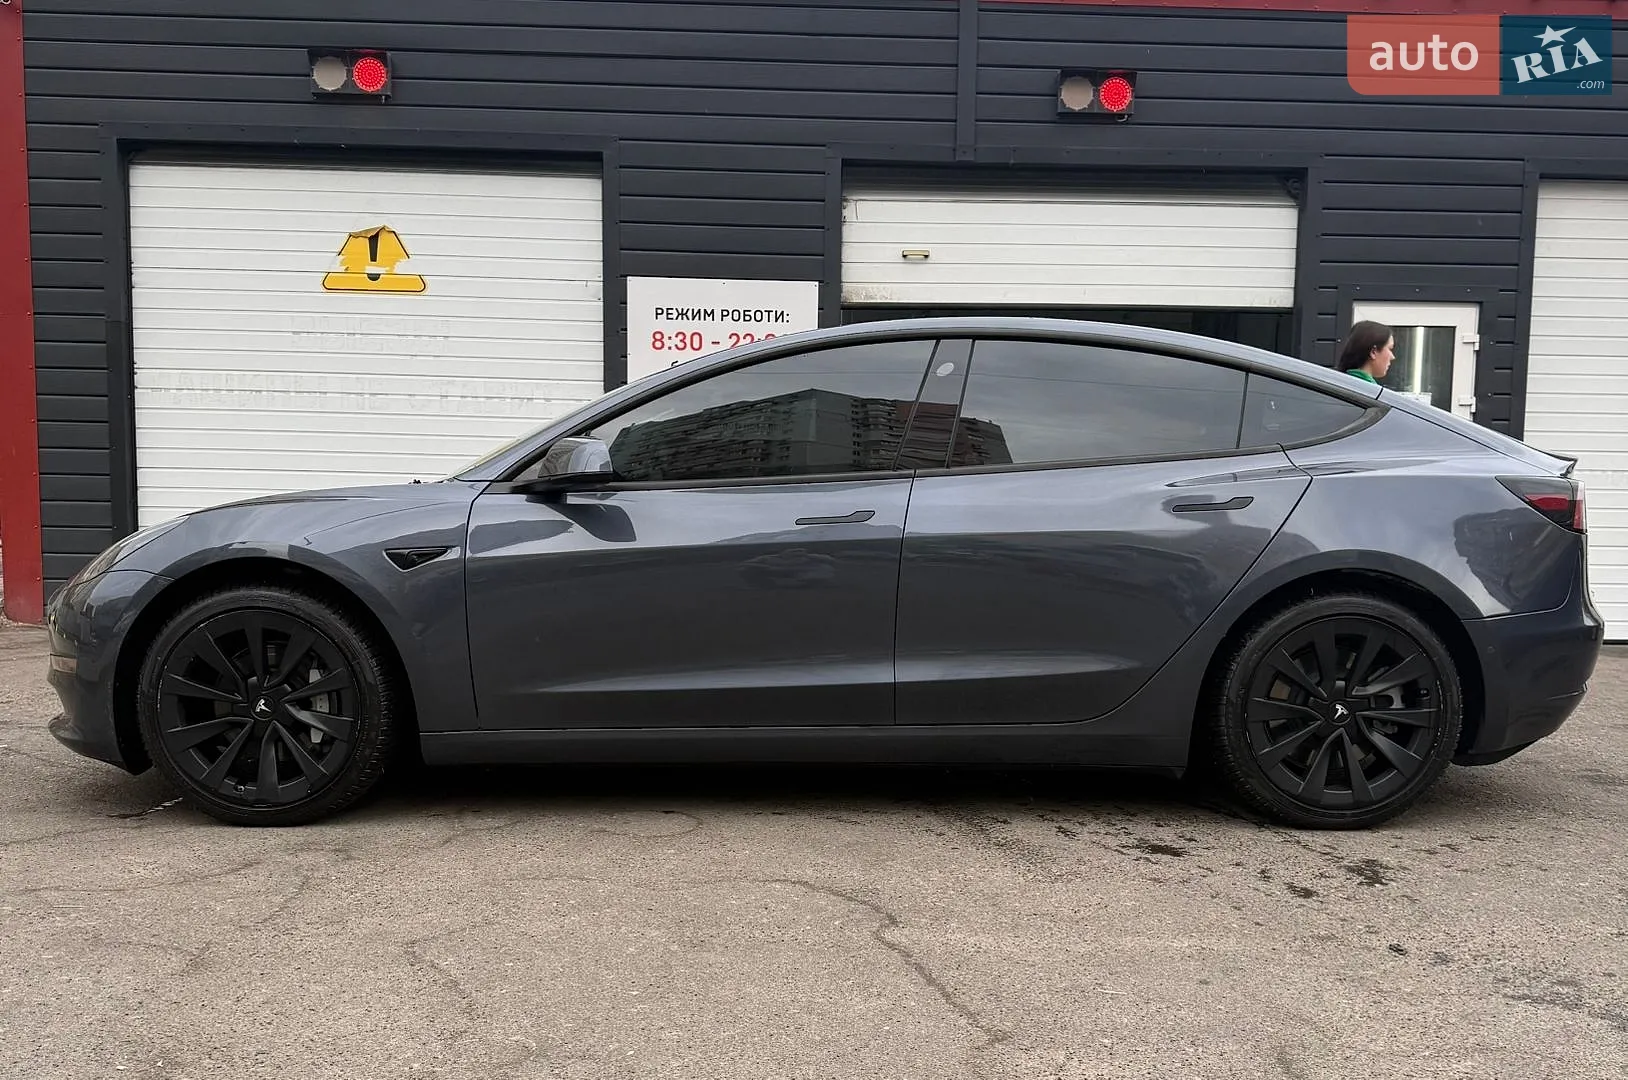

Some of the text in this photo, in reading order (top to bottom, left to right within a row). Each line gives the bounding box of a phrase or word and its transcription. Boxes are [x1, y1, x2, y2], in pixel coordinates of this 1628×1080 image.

[655, 307, 790, 323] РЕЖИМ РОБОТИ:
[652, 330, 703, 351] 8:30
